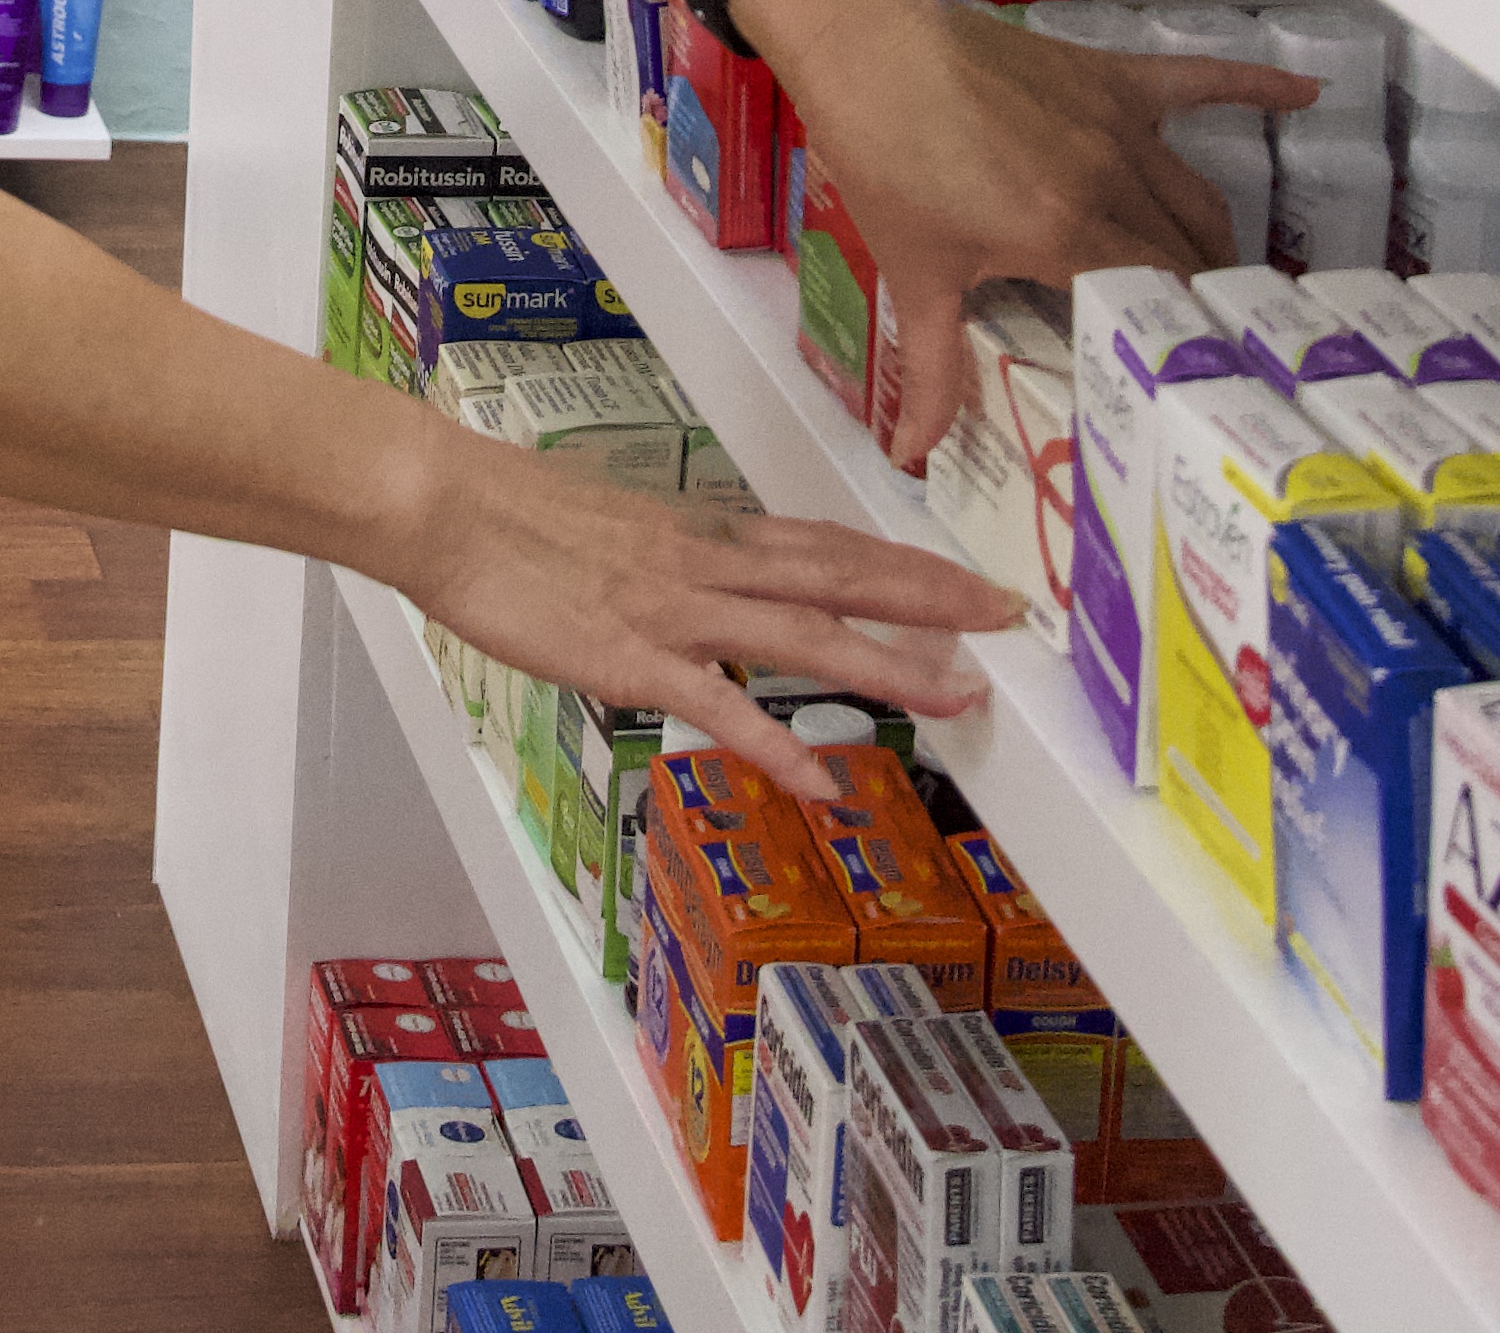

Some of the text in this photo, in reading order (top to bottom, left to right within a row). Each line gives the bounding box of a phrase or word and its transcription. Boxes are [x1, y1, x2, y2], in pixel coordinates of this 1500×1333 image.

[370, 167, 486, 187] Robitussin
[463, 289, 568, 309] sunmark
[1008, 957, 1085, 984] Delsy
[760, 995, 815, 1128] Coricidin
